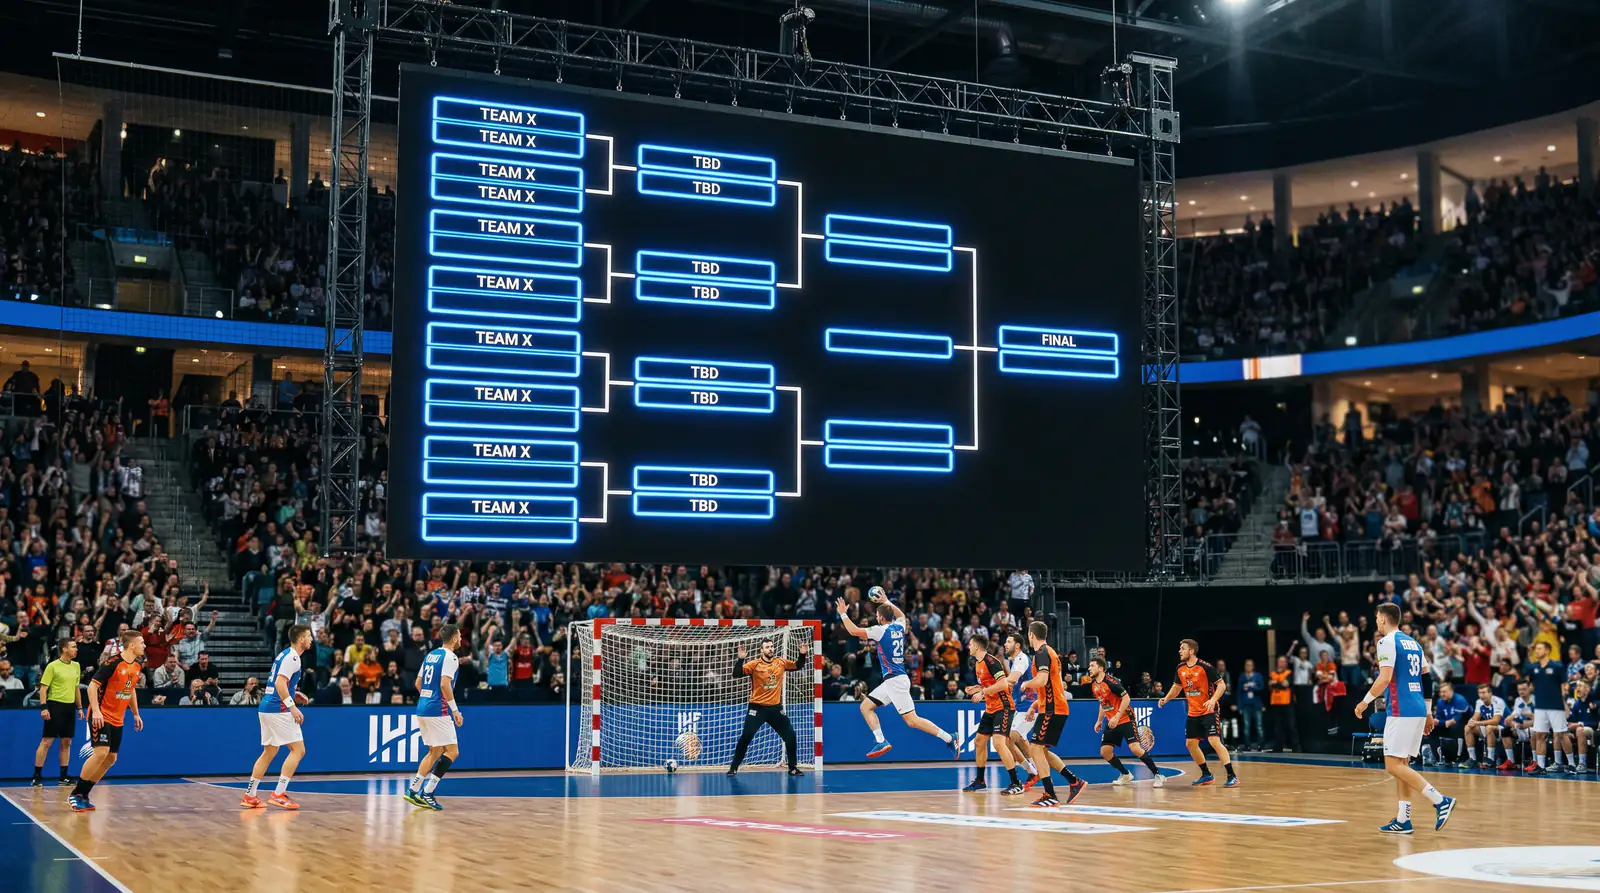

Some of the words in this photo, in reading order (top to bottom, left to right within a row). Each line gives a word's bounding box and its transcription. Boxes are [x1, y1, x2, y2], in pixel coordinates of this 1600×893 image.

[479, 107, 523, 126] TEAM
[526, 112, 537, 126] X
[479, 129, 522, 147] TEAM
[525, 134, 537, 148] X
[692, 155, 721, 170] TBD
[478, 162, 522, 180] TEAM
[525, 167, 536, 181] X
[477, 185, 522, 202] TEAM
[524, 189, 536, 203] X
[692, 180, 721, 195] TBD
[477, 218, 521, 235] TEAM
[524, 223, 535, 237] X
[691, 260, 720, 275] TBD
[476, 274, 520, 291] TEAM
[522, 278, 534, 292] X
[691, 285, 720, 300] TBD
[475, 330, 519, 346] TEAM
[521, 333, 533, 347] X
[1041, 333, 1077, 348] FINAL
[690, 365, 719, 380] TBD
[474, 386, 518, 402] TEAM
[520, 389, 532, 403] X
[690, 391, 719, 405] TBD
[472, 442, 517, 458] TEAM
[520, 445, 531, 459] X
[689, 473, 718, 488] TBD
[471, 499, 516, 515] TEAM
[518, 501, 530, 515] X
[689, 498, 718, 513] TBD
[1407, 652, 1421, 677] 33
